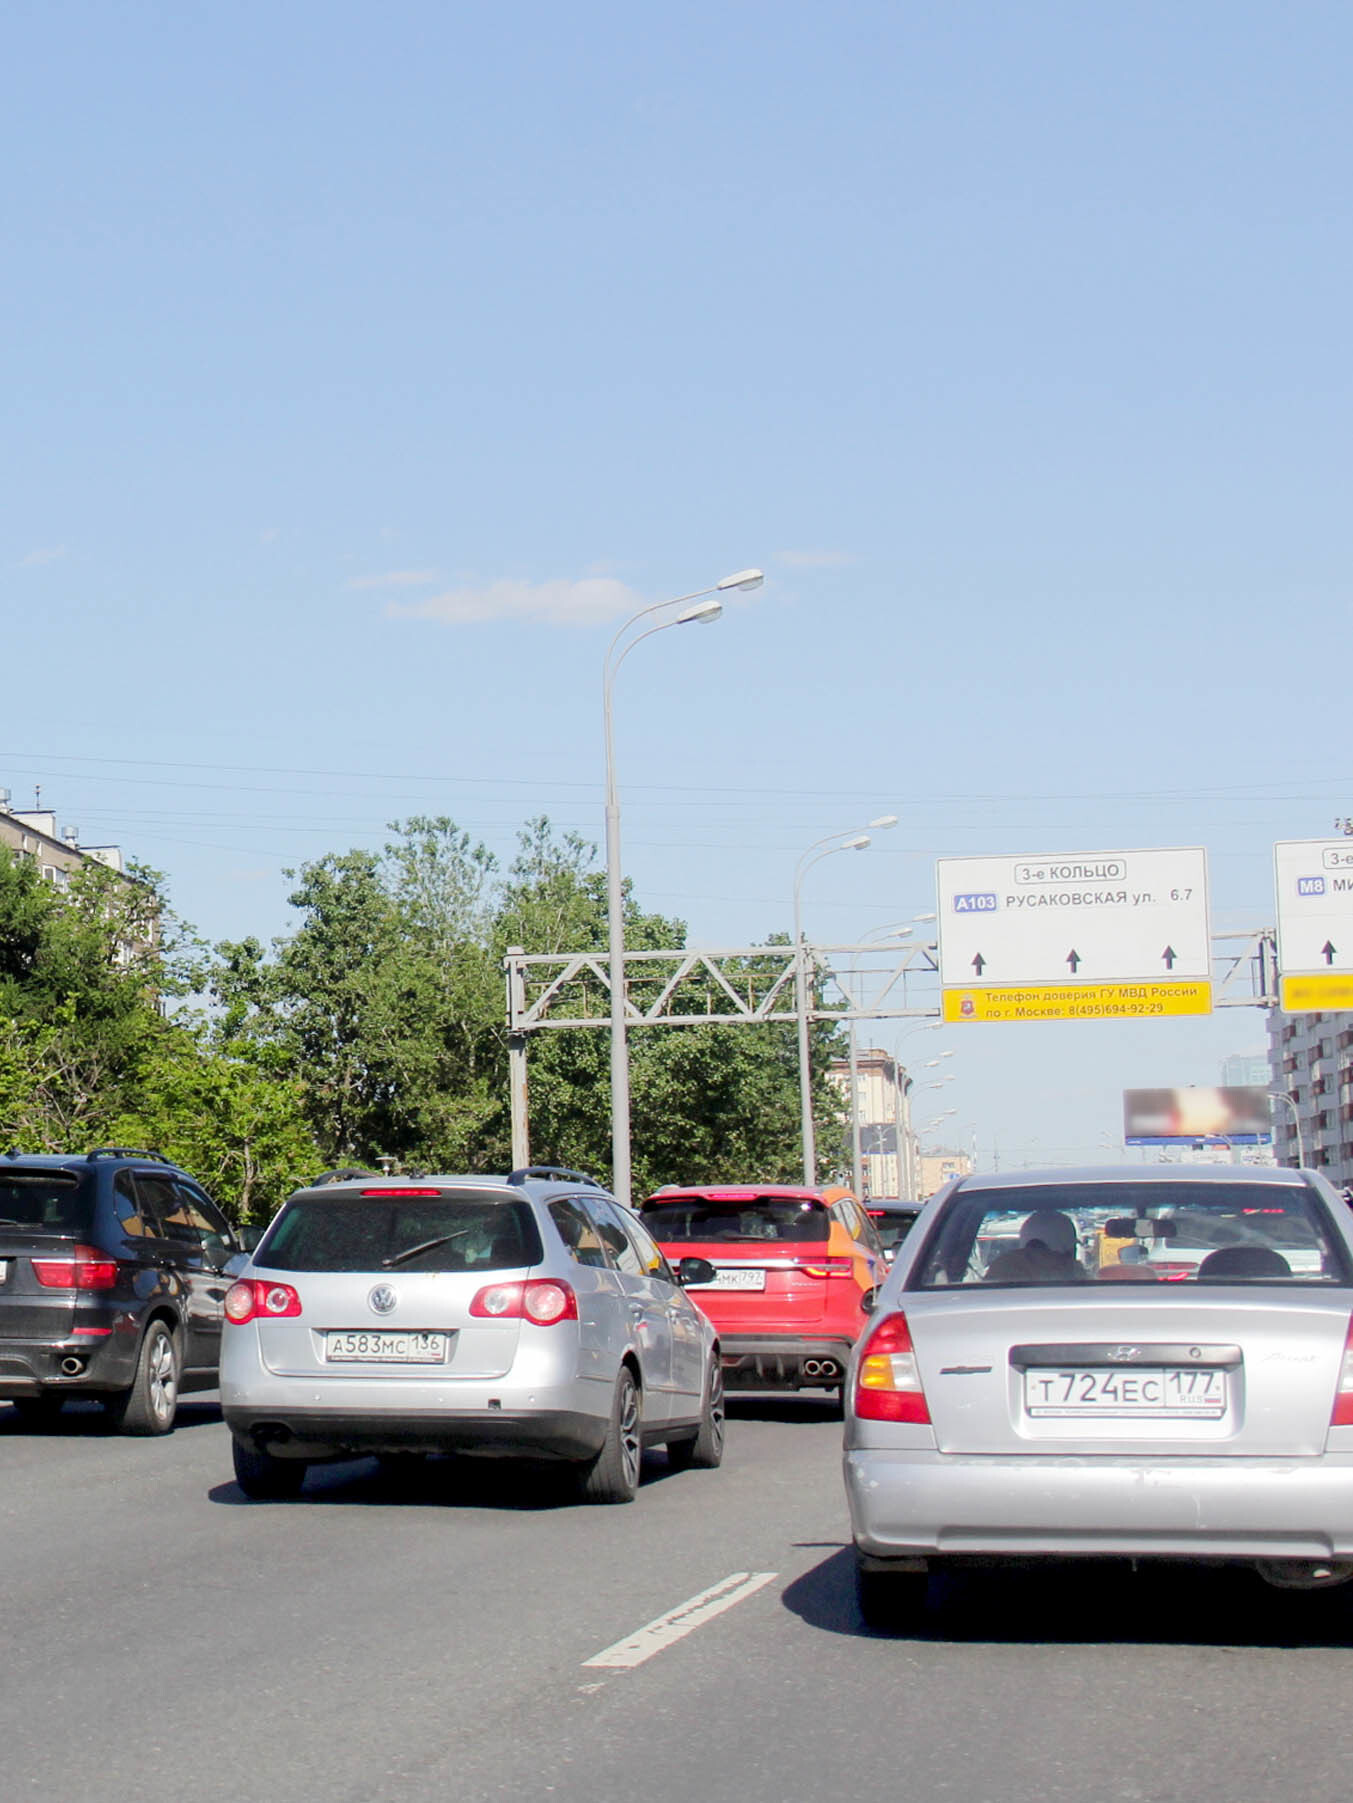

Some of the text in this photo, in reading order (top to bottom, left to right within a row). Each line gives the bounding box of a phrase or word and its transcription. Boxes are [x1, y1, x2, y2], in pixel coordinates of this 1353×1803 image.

[1021, 864, 1119, 880] 3-е КОЛЬЦО
[1299, 879, 1324, 894] М8
[956, 889, 1193, 911] А103 РУСАКОВСКАЯ ул. 6.7
[985, 987, 1198, 1003] Телефон доверия ГУ МВД России
[985, 1010, 1001, 1018] по
[1015, 1006, 1065, 1017] Москве:
[1068, 1003, 1164, 1016] 8(495)694-92-29
[332, 1334, 406, 1354] А583МС
[1038, 1371, 1215, 1402] Т724ЕС 177
